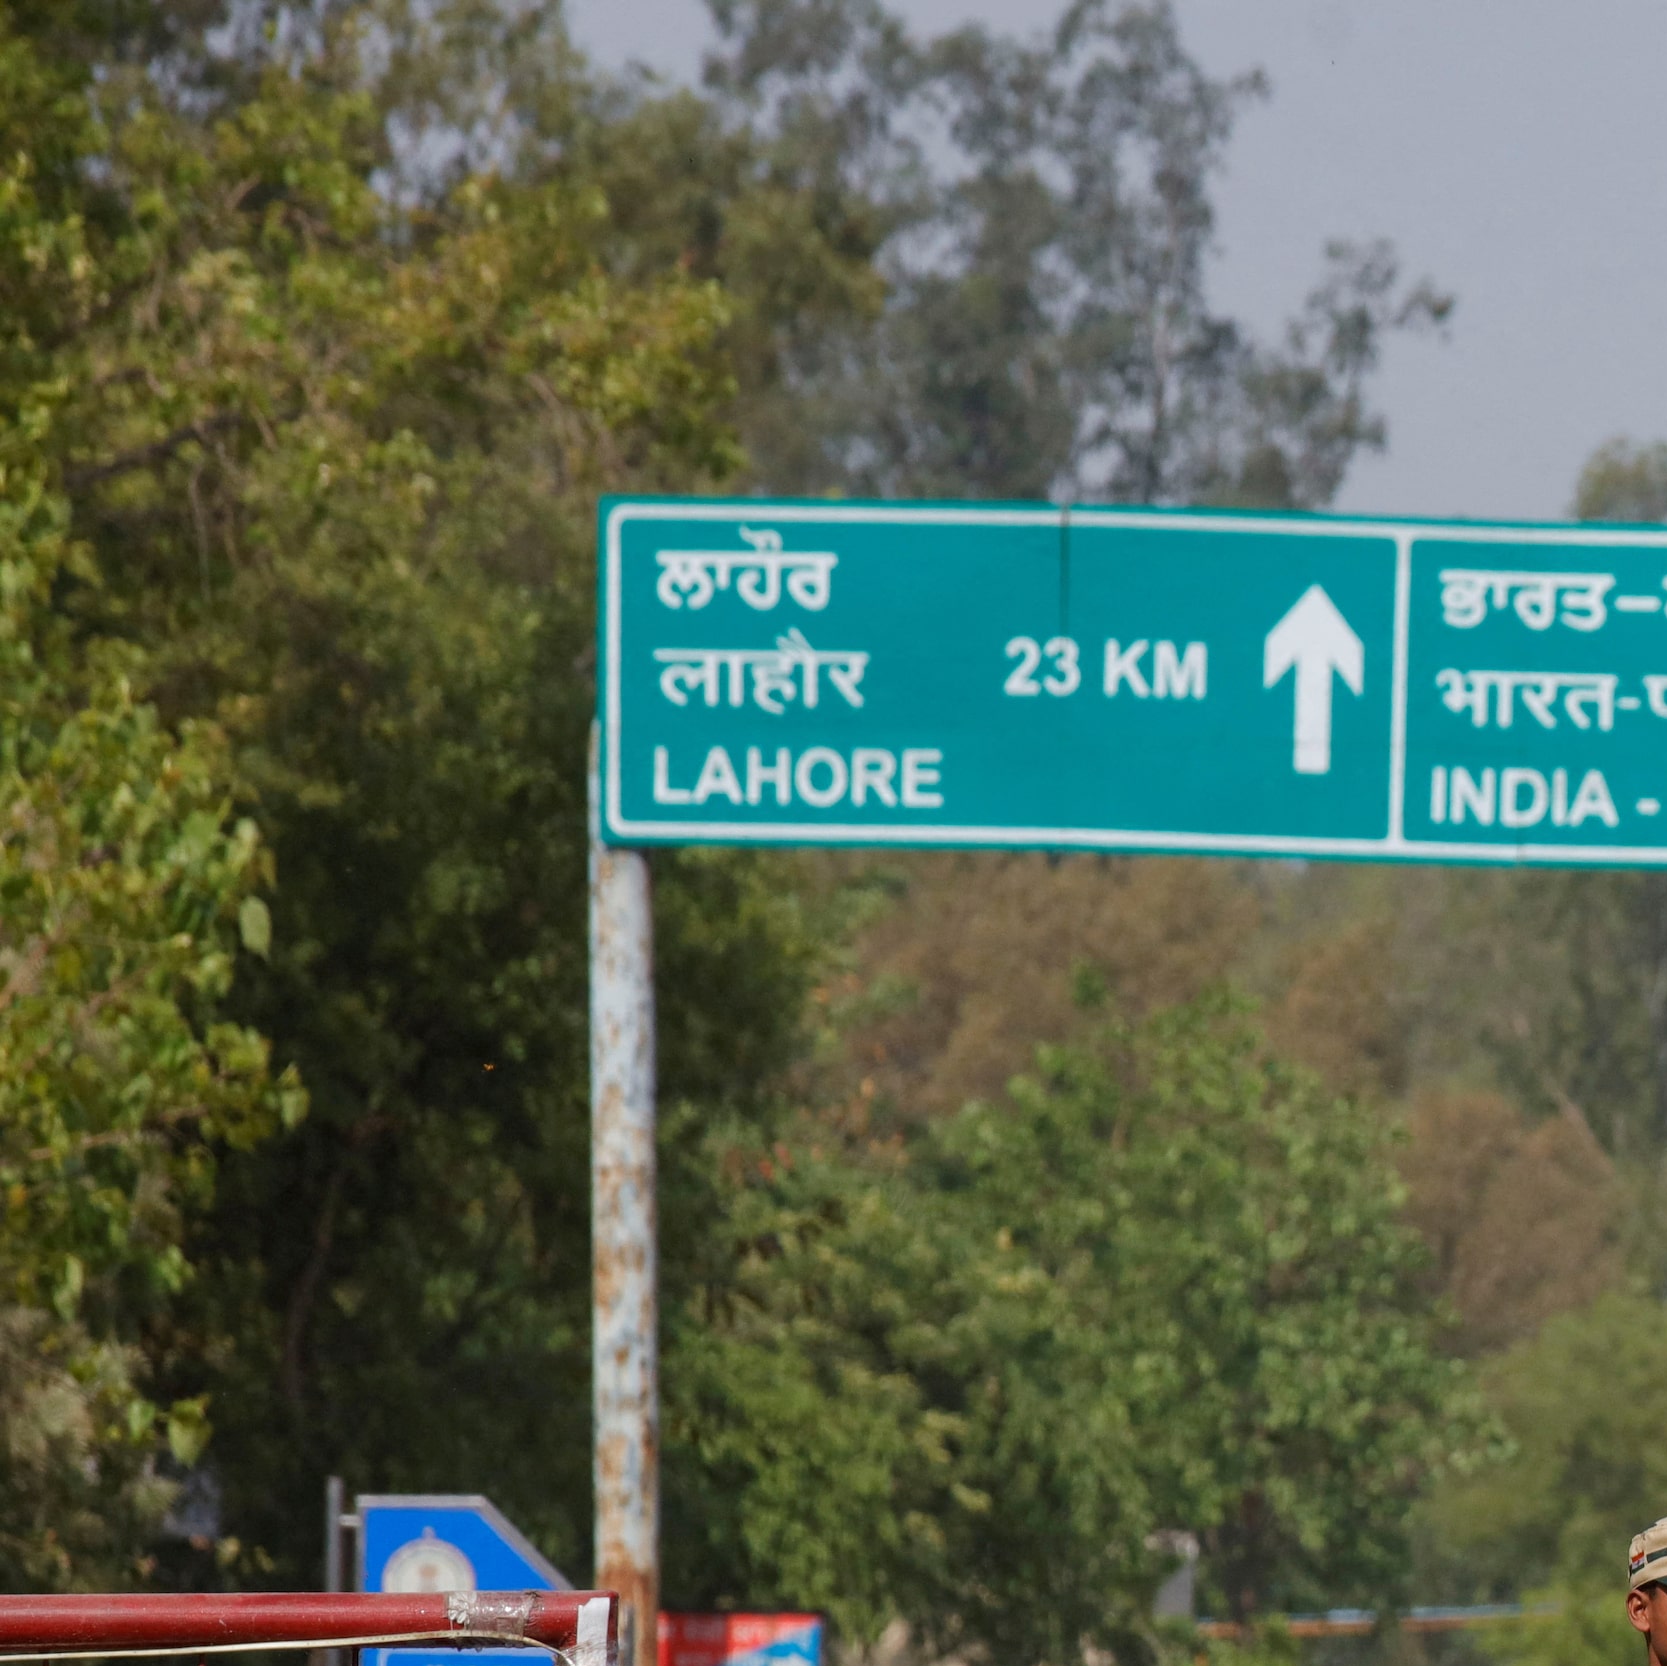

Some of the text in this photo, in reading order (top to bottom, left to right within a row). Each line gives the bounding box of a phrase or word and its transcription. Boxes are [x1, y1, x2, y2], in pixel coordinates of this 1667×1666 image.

[655, 525, 838, 611] ਲਾਹੌਰ
[653, 626, 871, 715] लाहौर
[1003, 636, 1208, 700] 23 KM
[652, 744, 945, 809] LAHORE
[1429, 766, 1619, 830] INDIA
